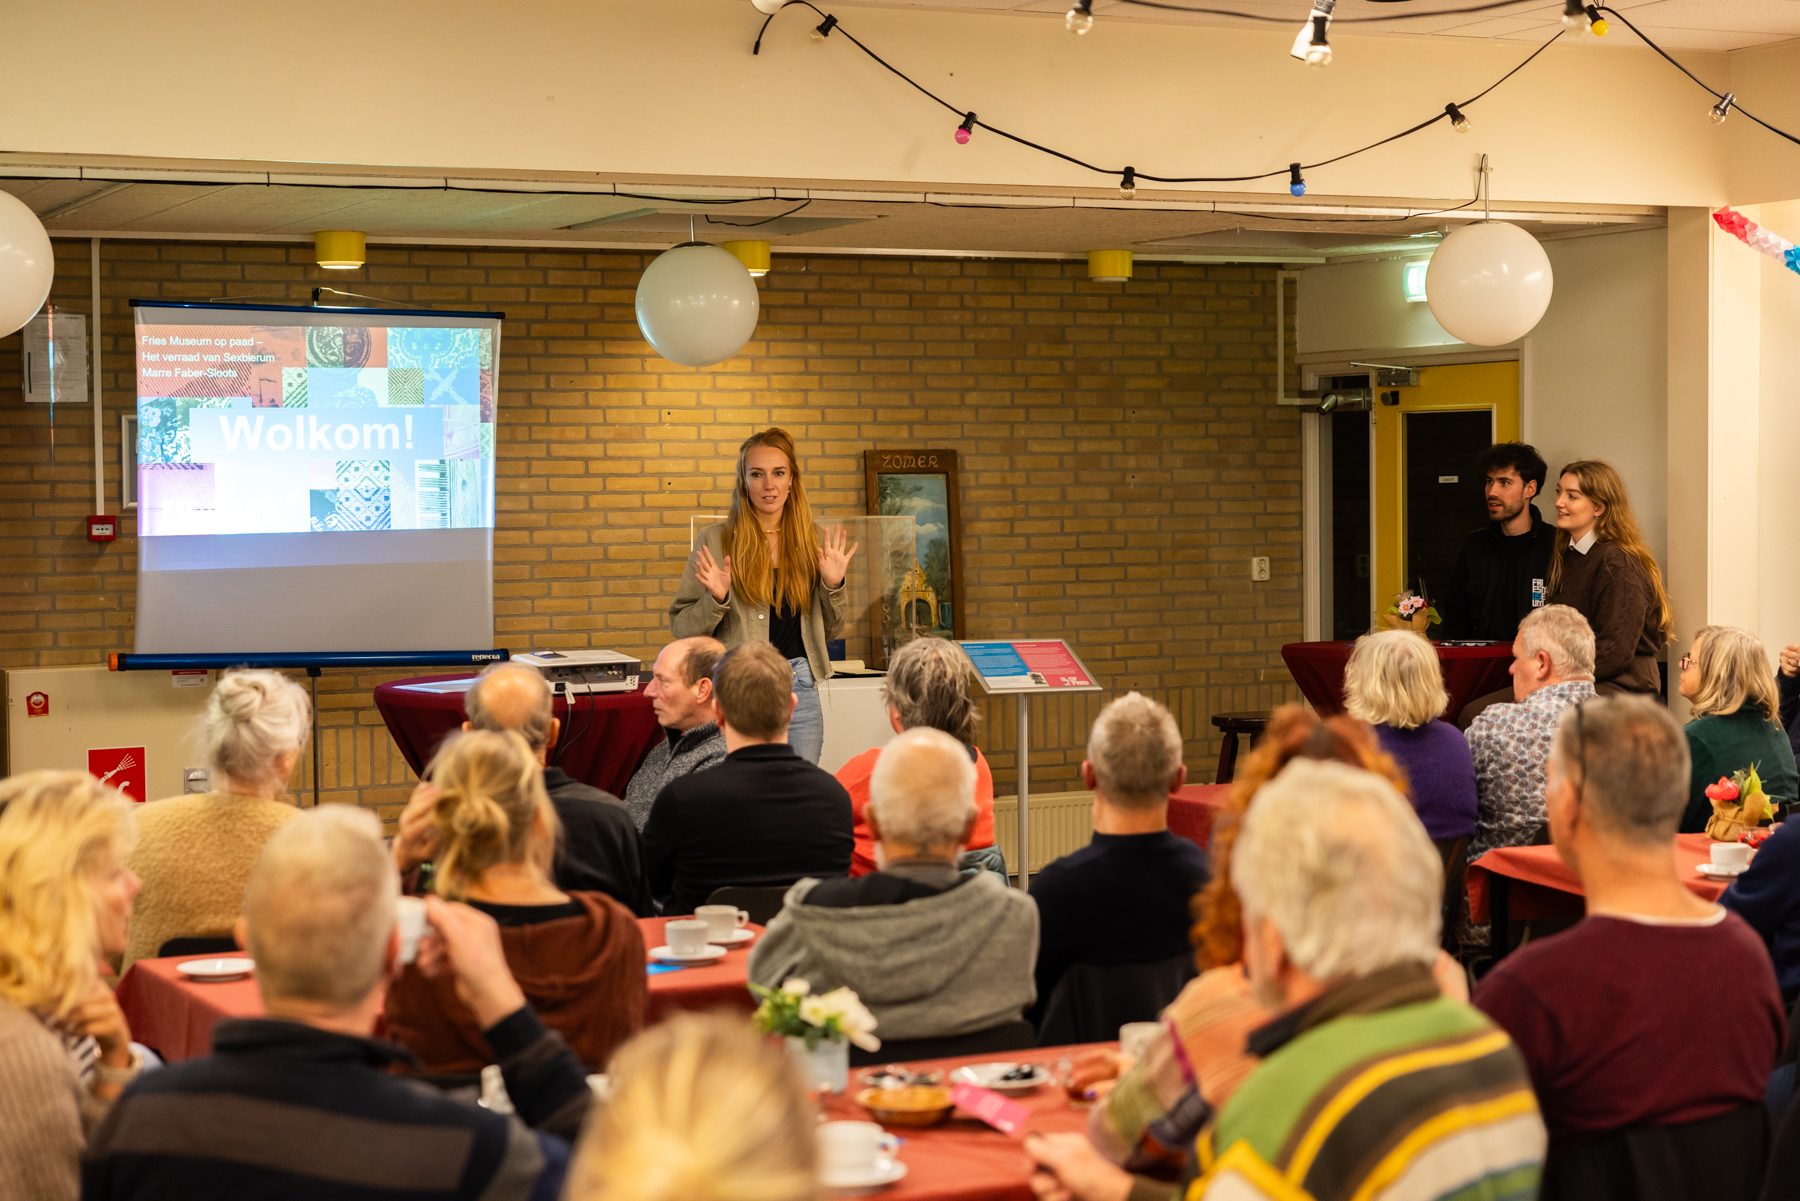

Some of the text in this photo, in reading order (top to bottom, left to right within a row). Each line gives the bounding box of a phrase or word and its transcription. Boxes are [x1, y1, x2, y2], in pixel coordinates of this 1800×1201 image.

[141, 336, 167, 346] Fries
[169, 336, 212, 346] Museum
[214, 338, 228, 348] op
[229, 337, 254, 348] paad
[142, 352, 275, 362] Het verraad van Sexbierum
[142, 368, 238, 378] Marre Faber-Sloots
[218, 414, 414, 451] Wolkom!
[882, 455, 939, 469] ZOMER
